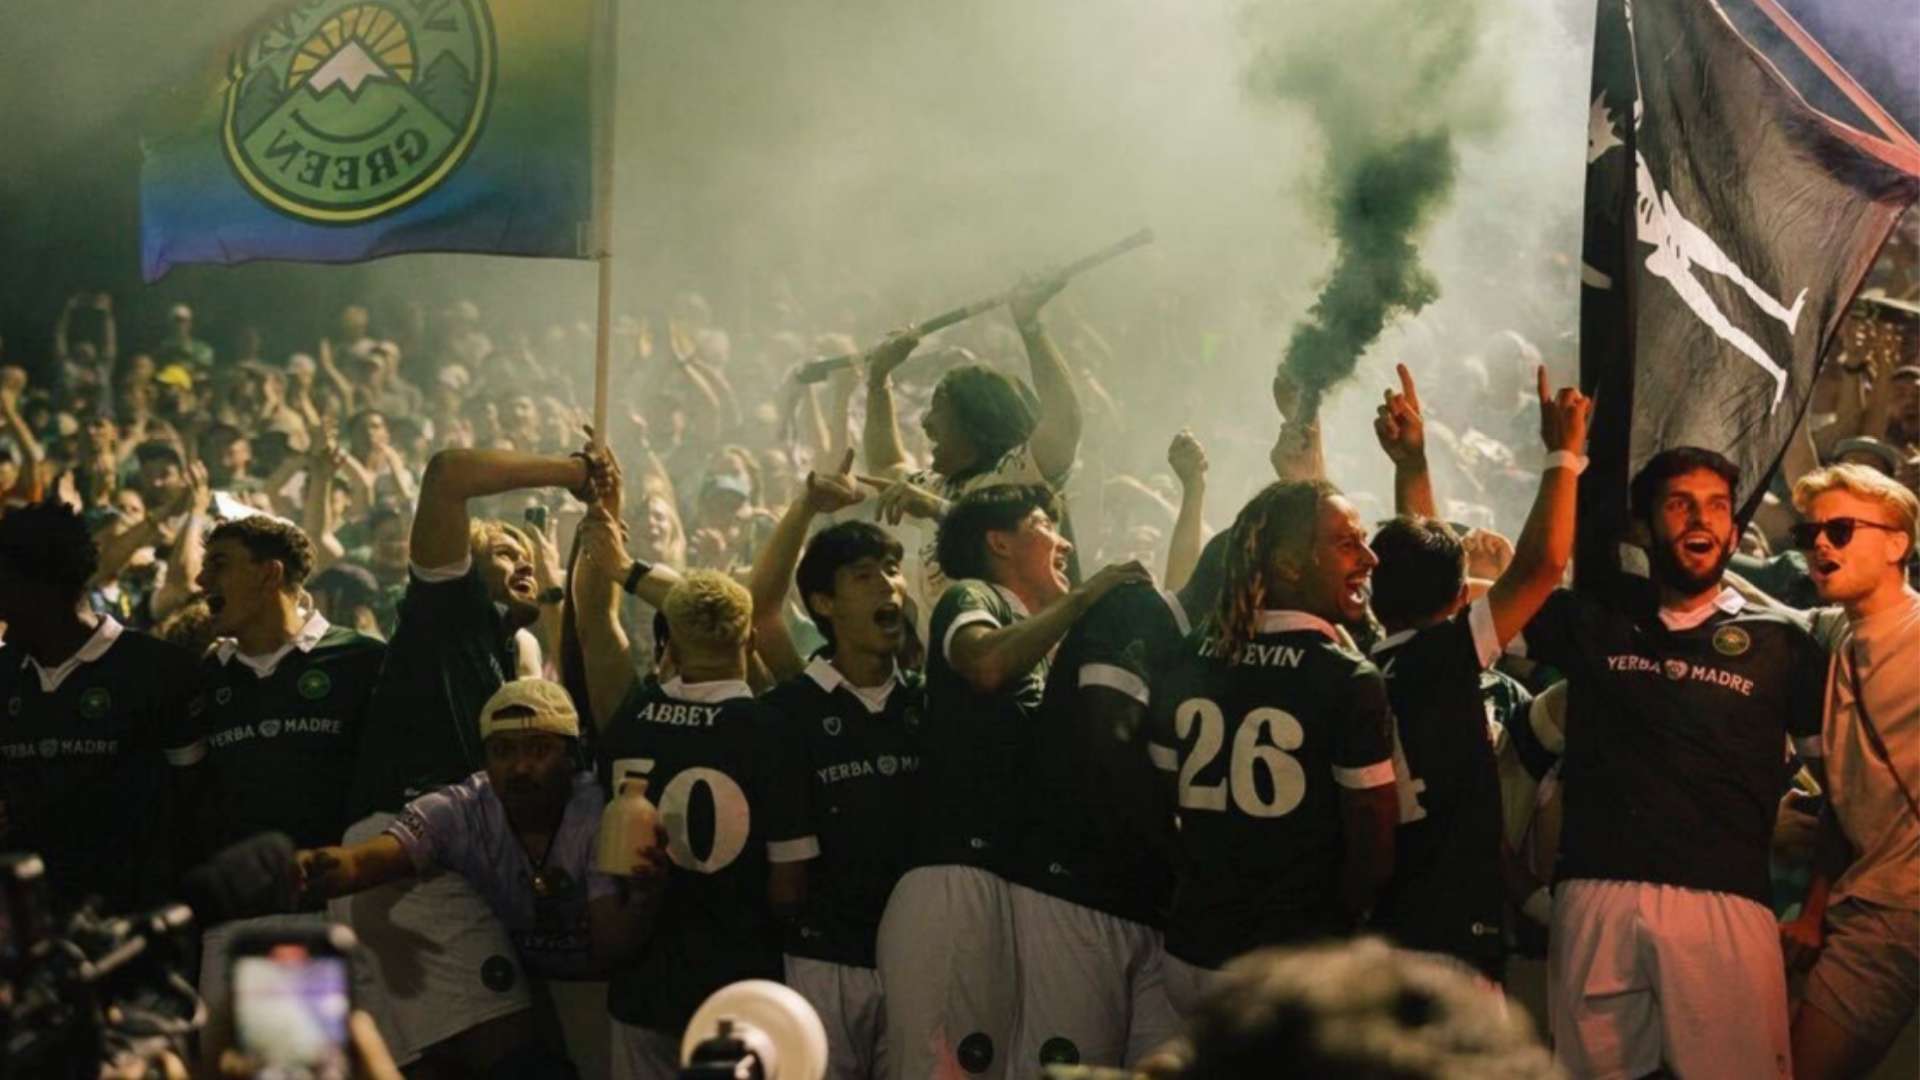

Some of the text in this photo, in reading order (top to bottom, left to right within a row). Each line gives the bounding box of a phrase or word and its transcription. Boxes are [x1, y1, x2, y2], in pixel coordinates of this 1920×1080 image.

[1606, 654, 1755, 696] YERBA MADRE
[637, 702, 723, 727] ABBEY
[208, 716, 343, 747] YERBA MADRE
[61, 738, 120, 755] MADRE
[1175, 697, 1306, 818] 26
[815, 760, 875, 784] YERBA
